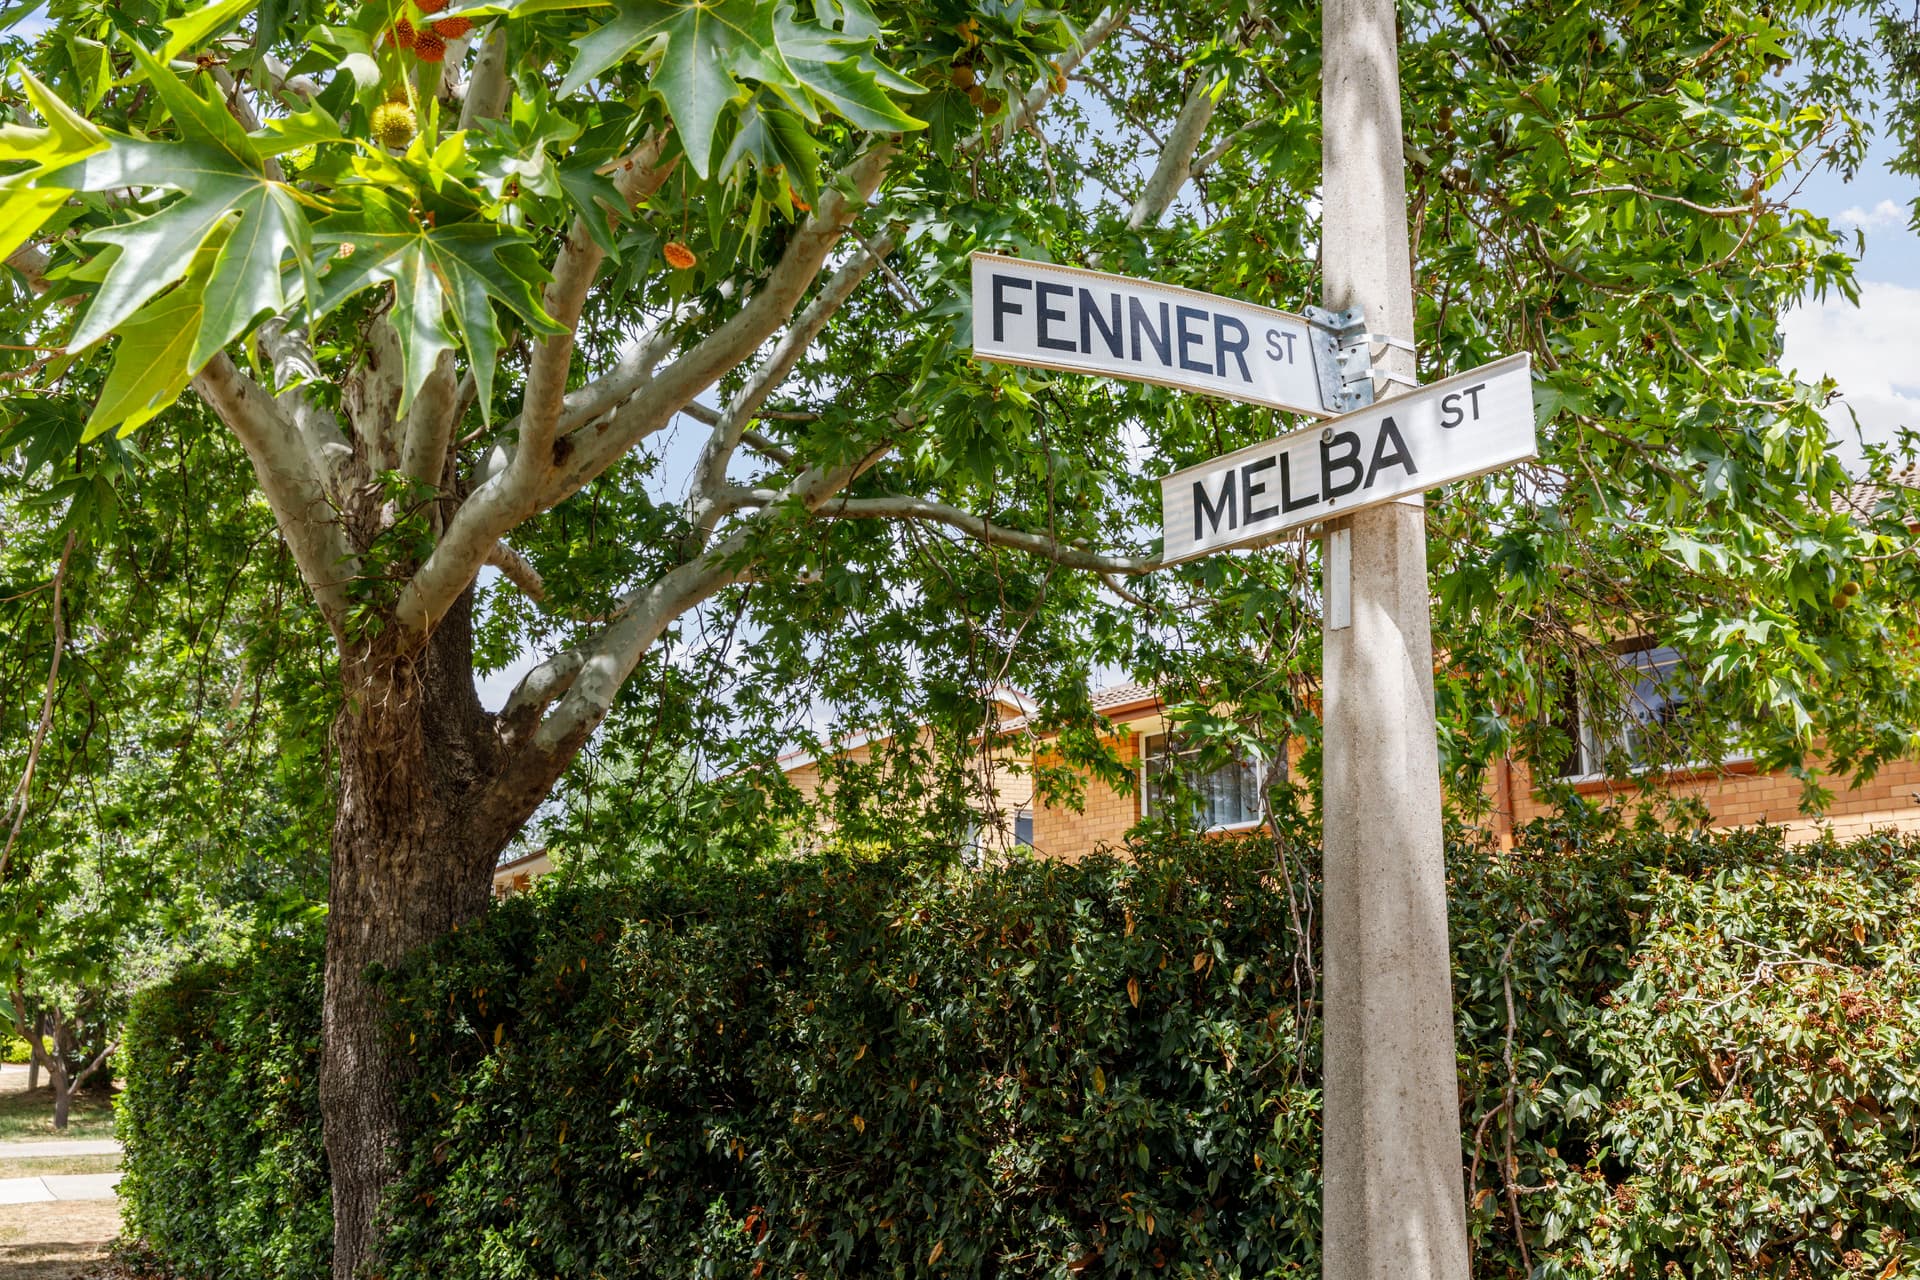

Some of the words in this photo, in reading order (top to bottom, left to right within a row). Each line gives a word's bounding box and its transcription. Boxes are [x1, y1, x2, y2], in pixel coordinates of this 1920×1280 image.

[992, 273, 1253, 383] FENNER
[1266, 329, 1297, 365] ST
[1193, 416, 1418, 540] MELBA
[1440, 383, 1486, 429] ST
